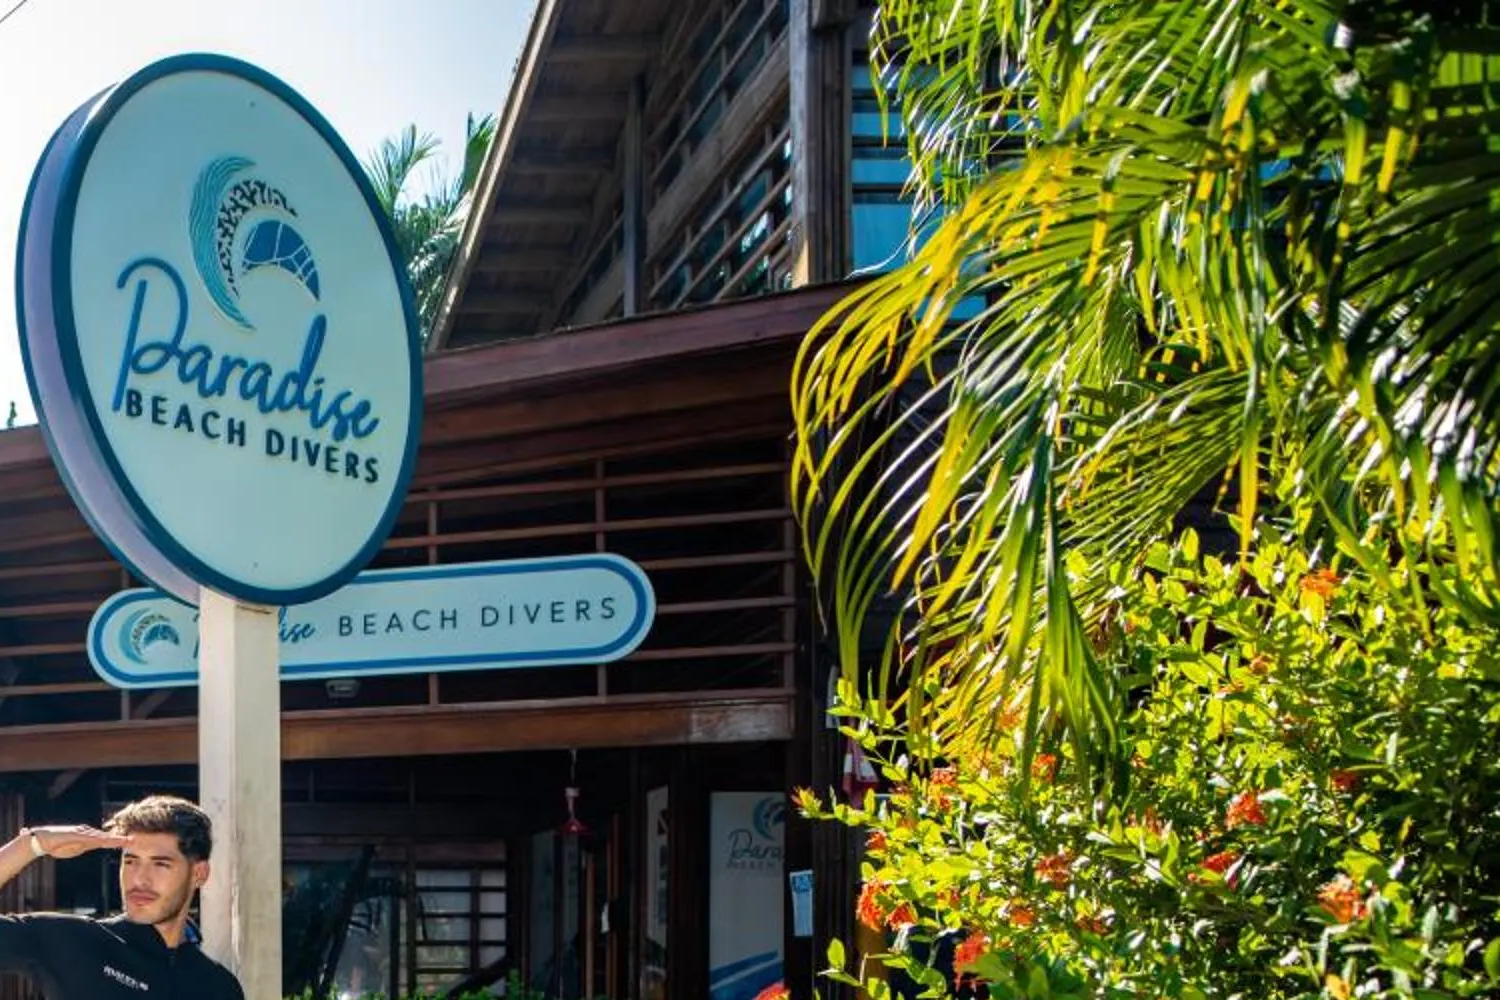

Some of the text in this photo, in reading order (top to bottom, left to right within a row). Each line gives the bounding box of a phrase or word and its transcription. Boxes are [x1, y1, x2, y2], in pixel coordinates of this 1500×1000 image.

[112, 257, 380, 442] Paradise
[125, 389, 379, 484] BEACH DIVERS
[339, 608, 457, 636] BEACH
[480, 597, 616, 628] DIVERS
